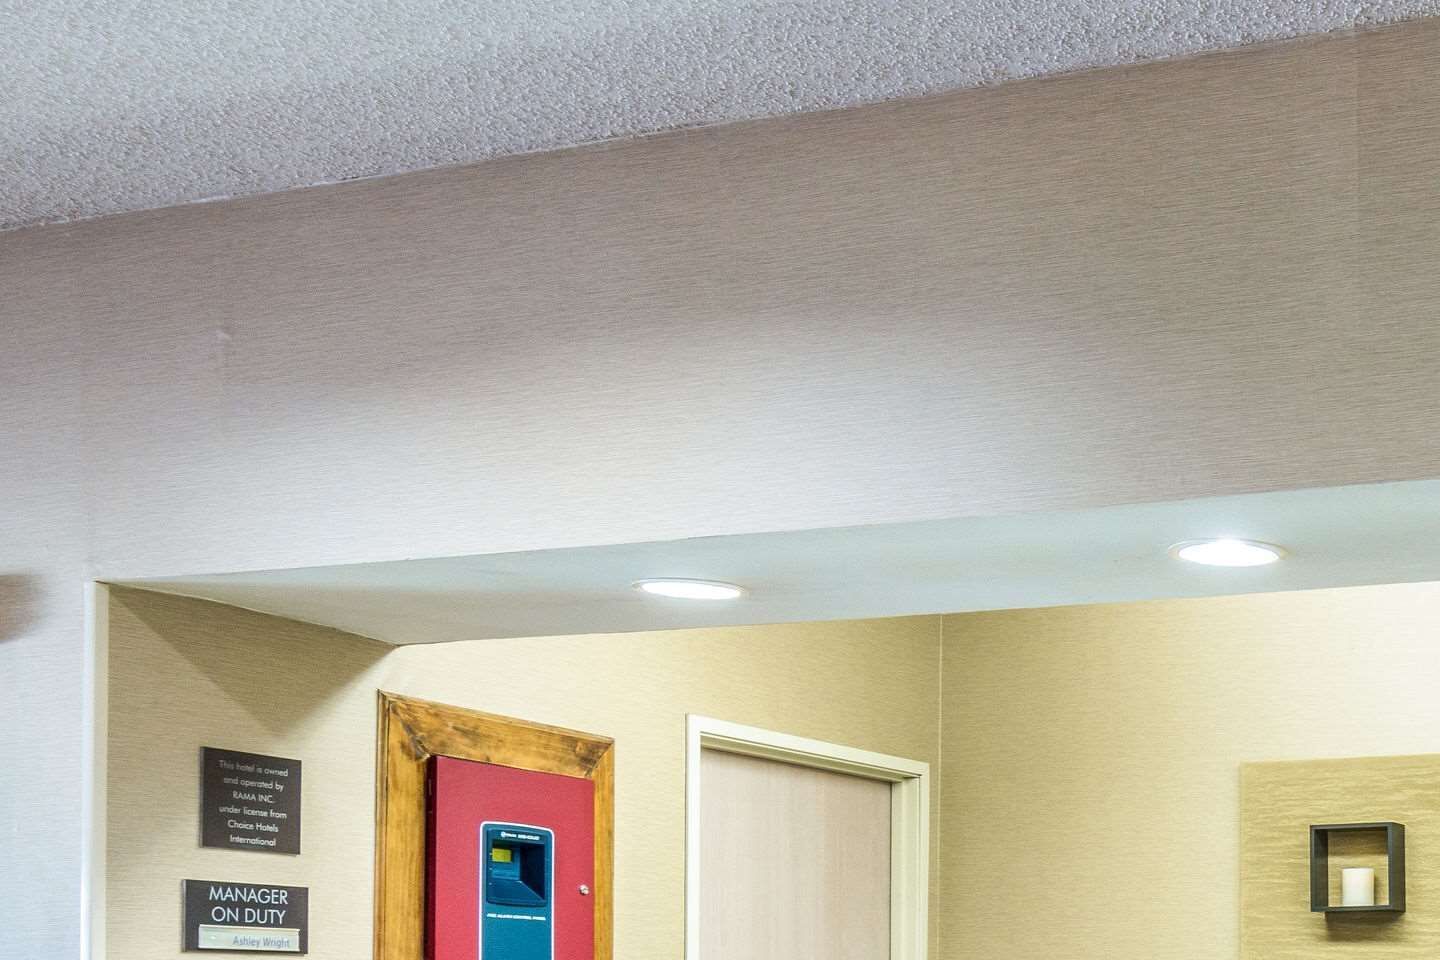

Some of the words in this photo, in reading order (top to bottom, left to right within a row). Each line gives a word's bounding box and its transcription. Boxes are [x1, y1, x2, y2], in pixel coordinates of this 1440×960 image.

[236, 762, 255, 774] hotel
[264, 768, 288, 777] owned
[223, 776, 239, 784] and
[240, 779, 273, 789] operated
[275, 781, 284, 792] by
[232, 790, 256, 801] RAMA
[218, 805, 241, 814] under
[243, 806, 268, 817] license
[270, 808, 287, 819] from
[227, 819, 254, 830] Choice
[255, 822, 279, 833] Hotels
[229, 834, 277, 847] International
[208, 886, 288, 905] MANAGER
[211, 905, 239, 923] ON
[244, 907, 286, 925] DUTY
[232, 935, 261, 948] Ashley
[263, 937, 290, 949] Wright
